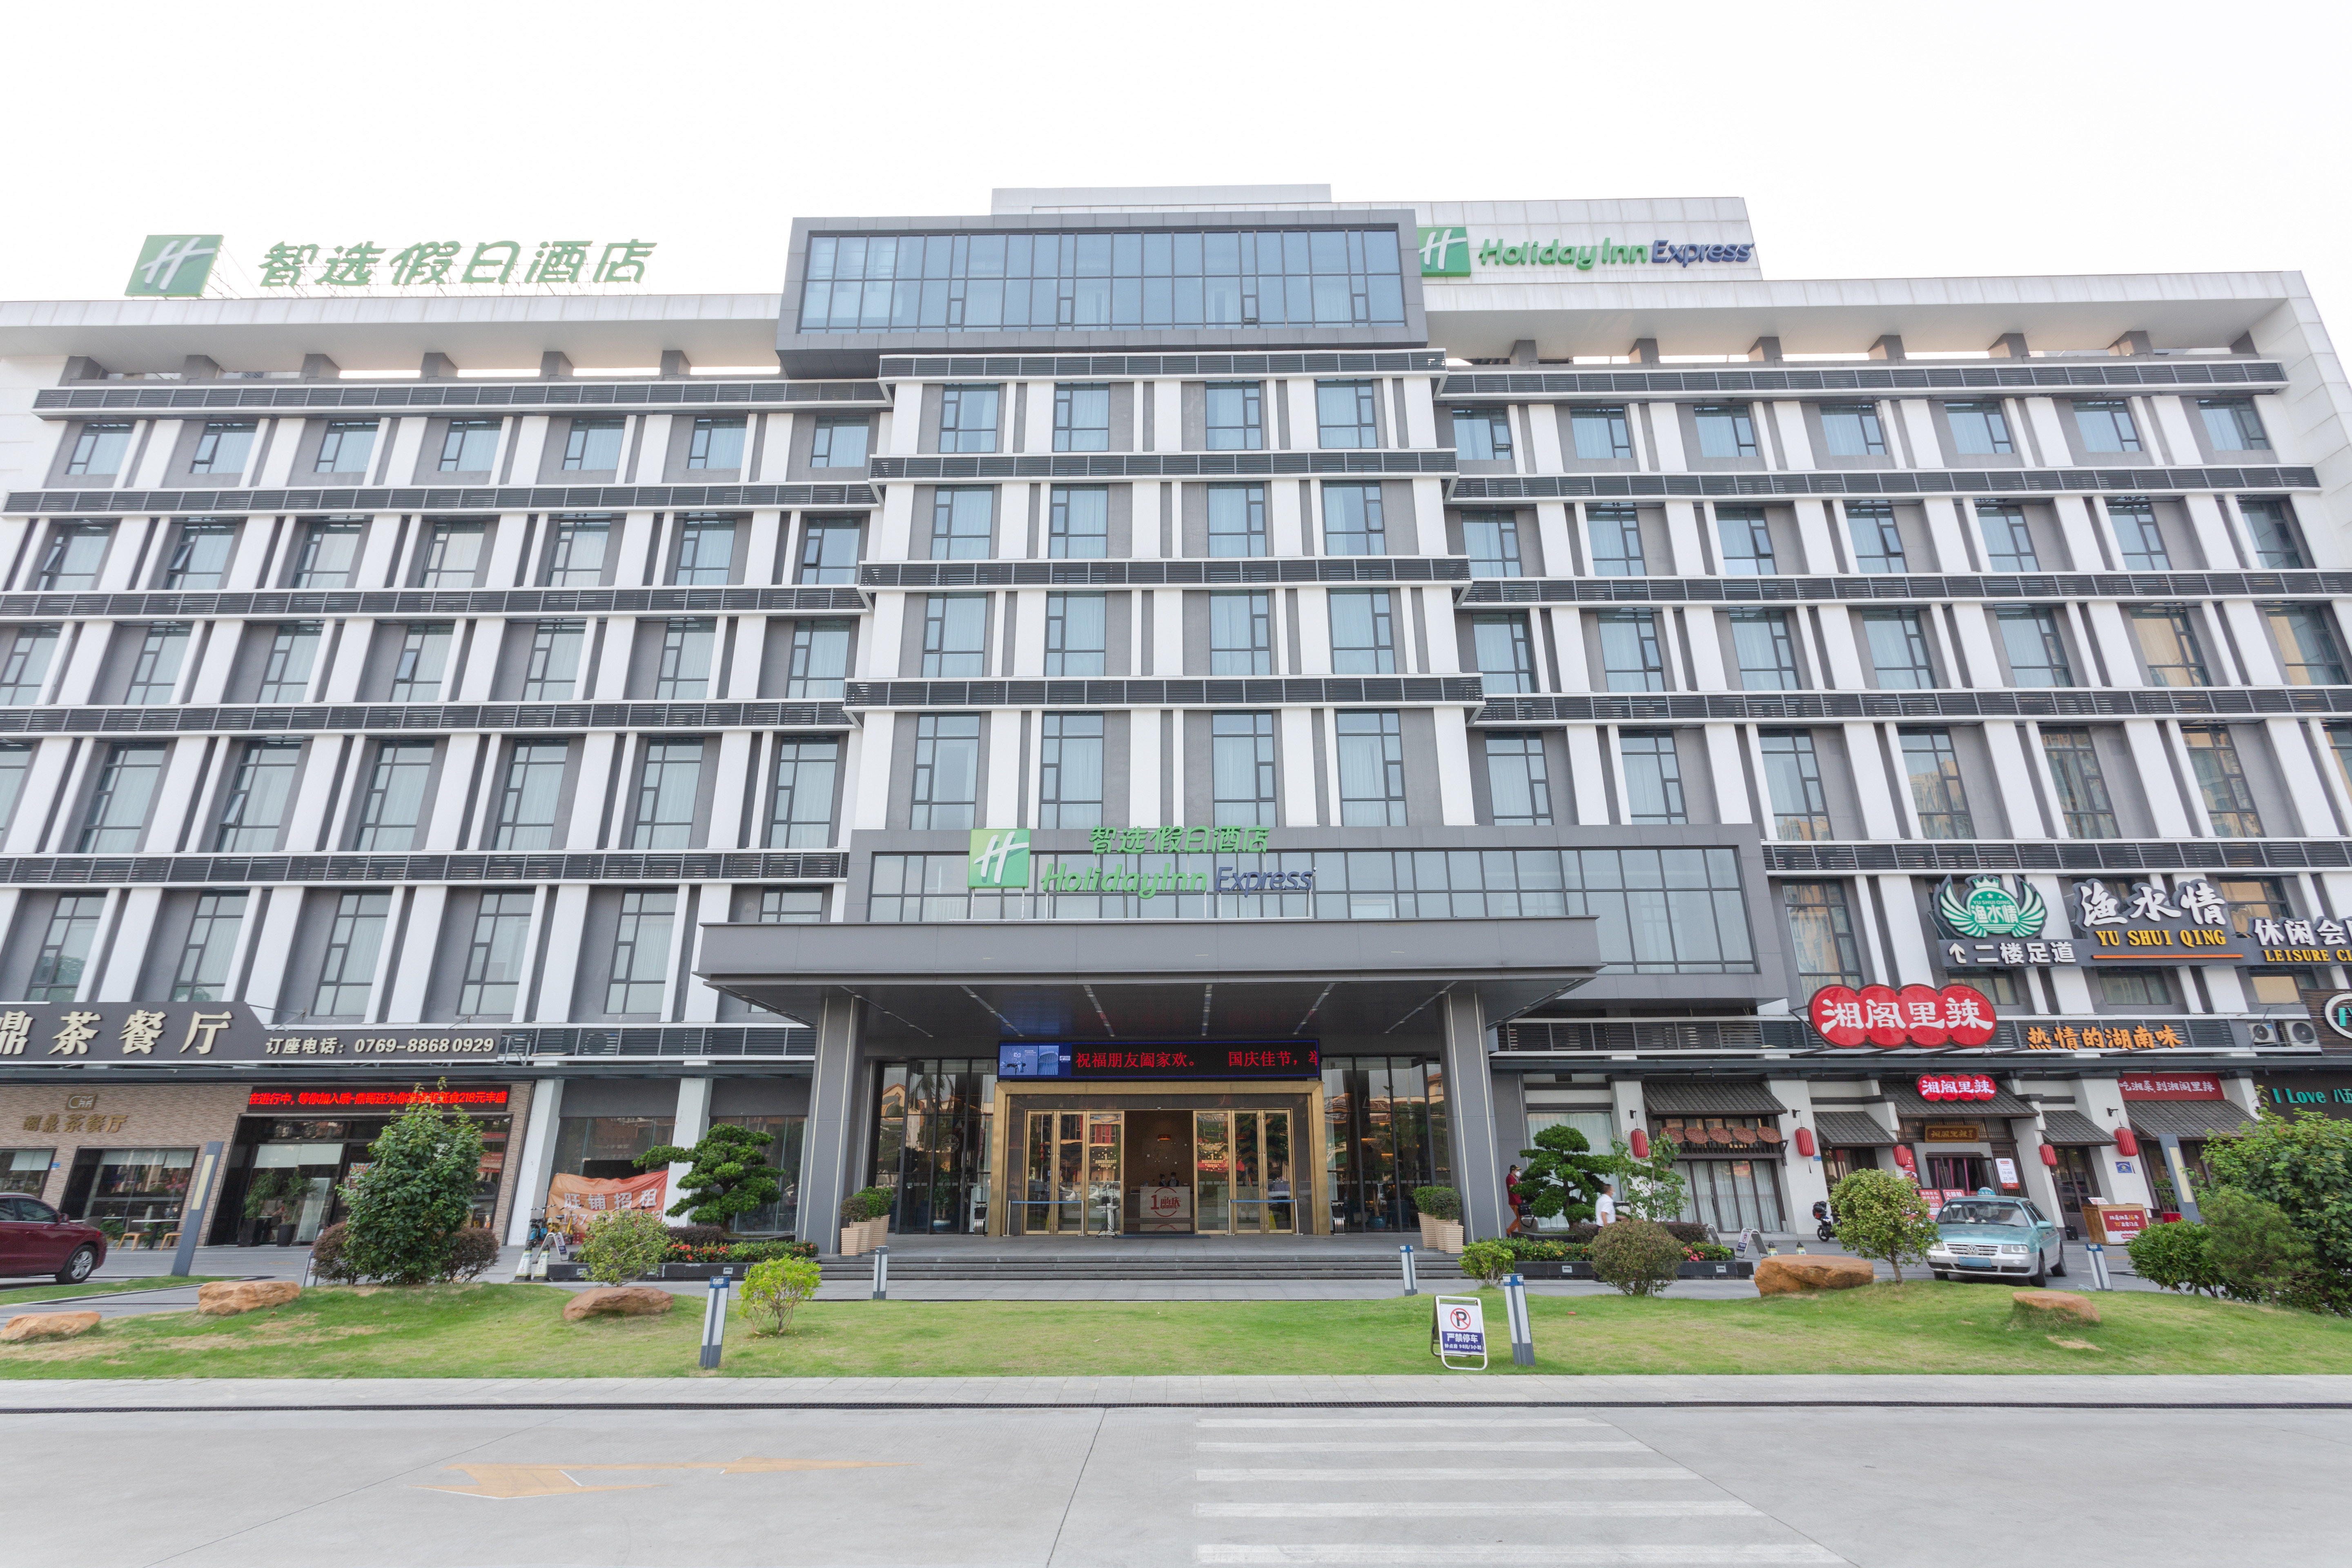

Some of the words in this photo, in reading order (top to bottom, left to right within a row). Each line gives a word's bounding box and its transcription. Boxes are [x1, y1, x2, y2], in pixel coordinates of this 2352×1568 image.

[259, 239, 657, 287] 智选假日酒店
[1479, 238, 1597, 270] Holiday
[1601, 237, 1648, 265] Inn
[1652, 240, 1752, 268] Express
[1089, 824, 1270, 854] 智选假日酒店
[1040, 863, 1160, 899] Holiday
[1165, 863, 1208, 892] Inn
[1215, 866, 1313, 898] Express
[1971, 905, 2019, 924] 渔水情
[2080, 881, 2227, 927] 渔水情
[2096, 931, 2120, 946] YU
[2127, 930, 2172, 946] SHUI
[2180, 929, 2226, 947] QING
[2254, 919, 2352, 946] 休闲会
[1975, 942, 2076, 964] 二楼足道
[2264, 950, 2331, 961] LEISURE
[1821, 998, 1993, 1034] 湘阁里辣
[2027, 1025, 2183, 1051] 热情的湖南味
[1922, 1079, 1995, 1095] 湘阁里辣
[2272, 1088, 2281, 1103] I
[2285, 1088, 2327, 1103] Love
[564, 1189, 657, 1210] 旺铺招租
[1447, 1333, 1478, 1343] 严禁停车
